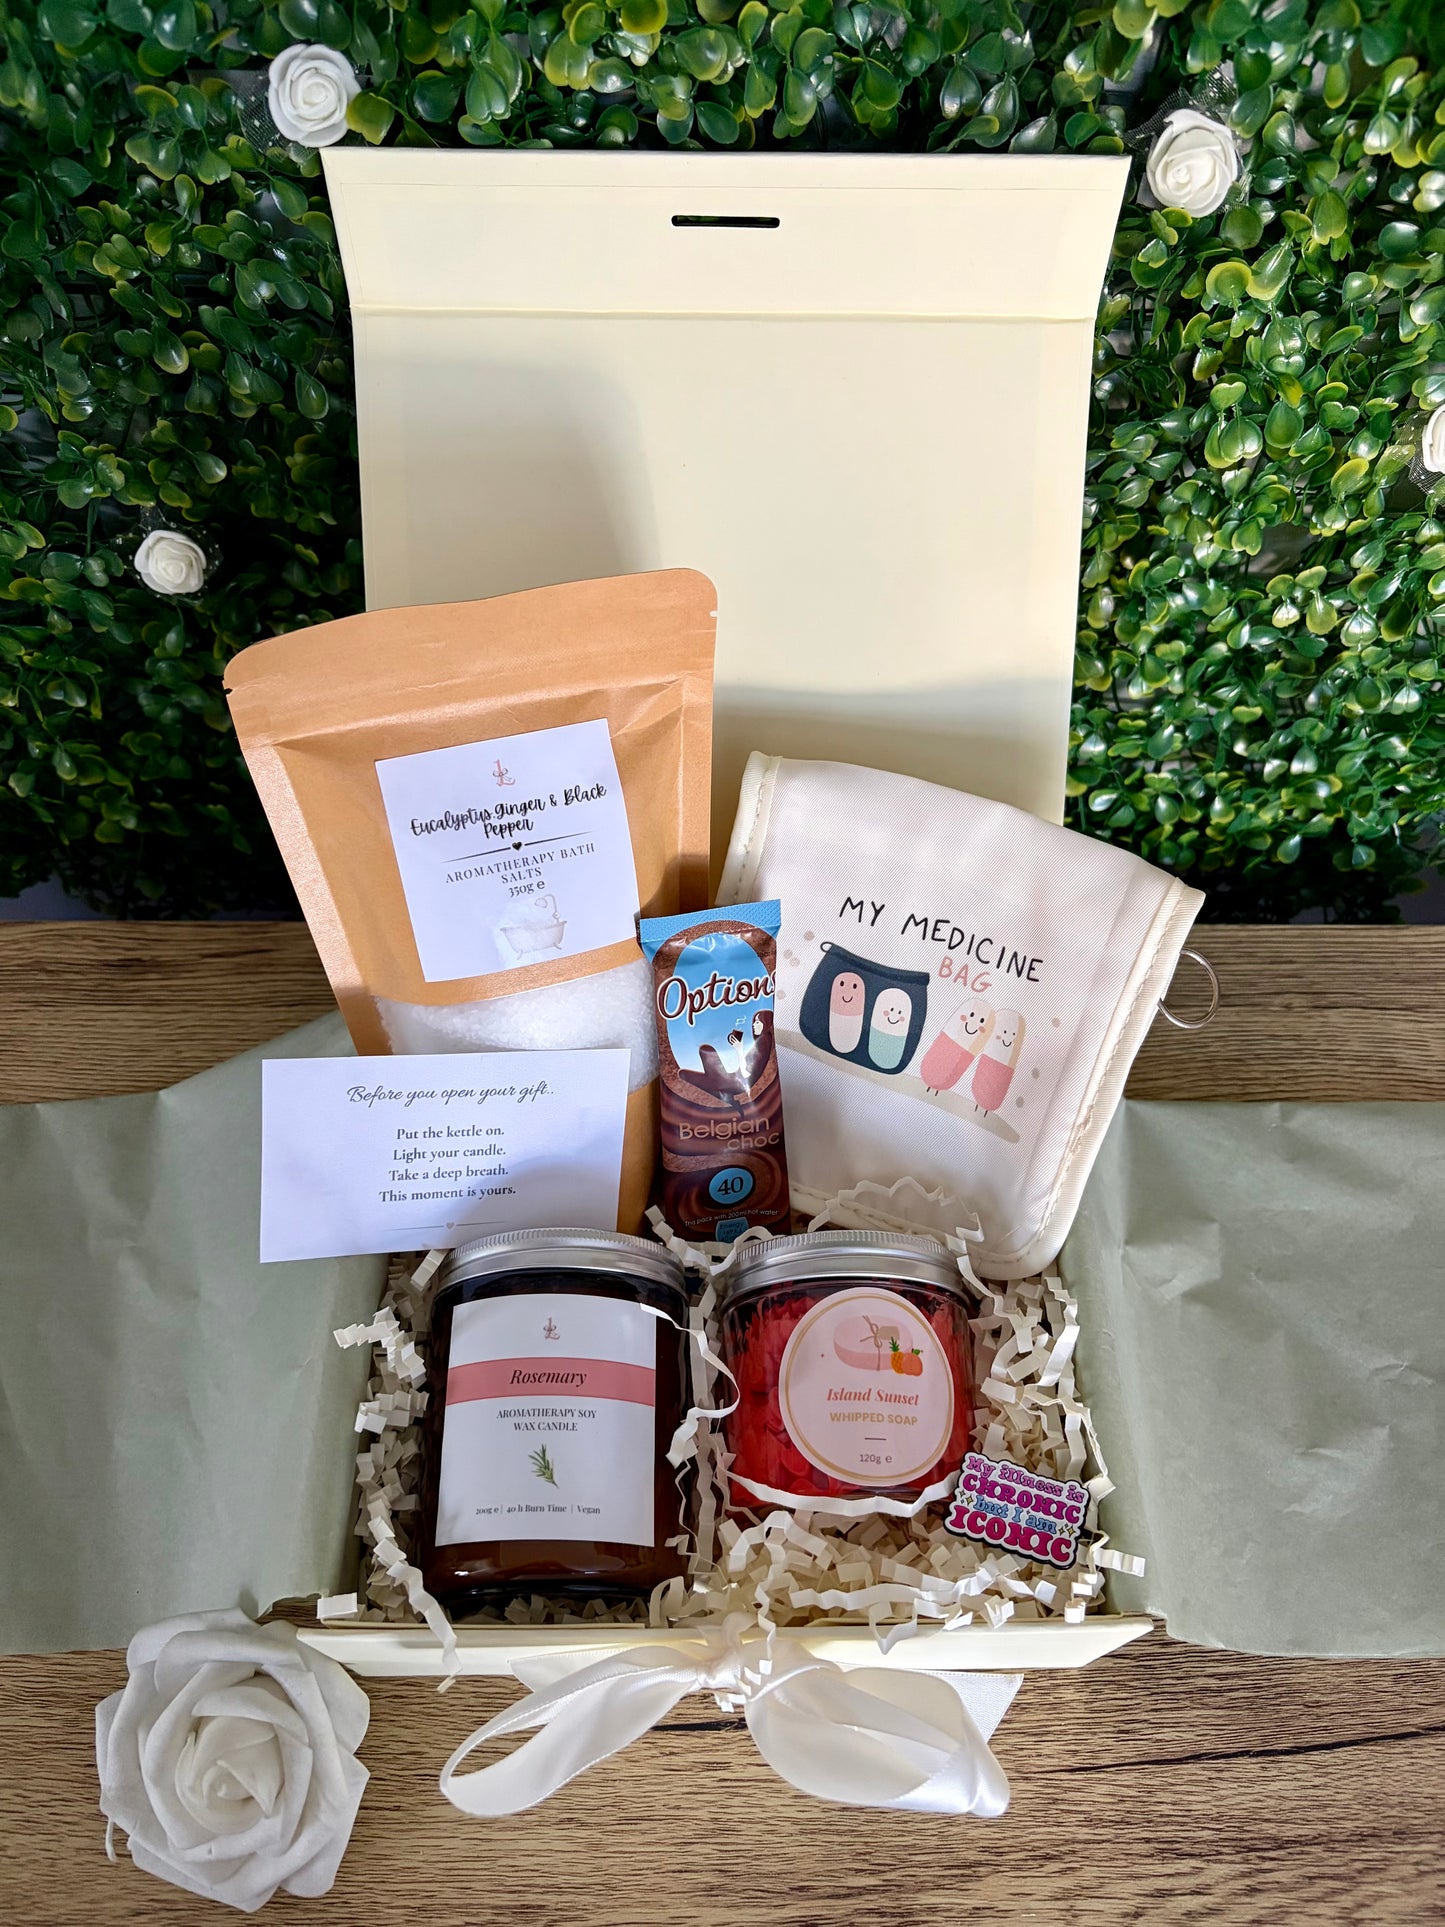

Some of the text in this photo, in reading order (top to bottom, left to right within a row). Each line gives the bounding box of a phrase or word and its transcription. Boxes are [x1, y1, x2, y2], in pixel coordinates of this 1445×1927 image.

[549, 794, 558, 807] &
[564, 783, 607, 806] Black
[483, 819, 534, 839] Pepper
[445, 843, 596, 884] AROMATHERAPY BATH
[501, 867, 543, 884] SALTS
[509, 881, 535, 898] 350g
[839, 896, 1044, 982] MY MEDICINE
[938, 955, 992, 993] BAG
[347, 1084, 403, 1108] Before
[405, 1088, 437, 1107] you
[441, 1088, 476, 1106] open
[478, 1085, 515, 1106] your
[397, 1125, 505, 1140] Put the kettle on.
[678, 1117, 770, 1141] Belgian
[726, 1132, 780, 1151] choc
[393, 1144, 506, 1164] Light your candle.
[388, 1164, 509, 1183] Take a deep breath.
[379, 1185, 516, 1202] This moment is yours.
[717, 1176, 744, 1195] 40
[696, 1217, 713, 1225] pack
[510, 1368, 587, 1388] Rosemary
[826, 1387, 919, 1406] Island Sunset
[496, 1408, 597, 1419] AROMATHERAPY SOY
[830, 1412, 918, 1426] WHIPPED SOAP
[513, 1422, 578, 1431] WAX CANDLE
[859, 1454, 882, 1464] 120g
[966, 1456, 1085, 1504] My illness is
[962, 1473, 1081, 1524] CHRONIC
[517, 1504, 523, 1513] h
[525, 1504, 545, 1513] Burn
[546, 1504, 567, 1513] Time
[577, 1505, 601, 1515] Vegan
[973, 1495, 1057, 1535] but I am
[949, 1504, 1072, 1562] ICONIC
